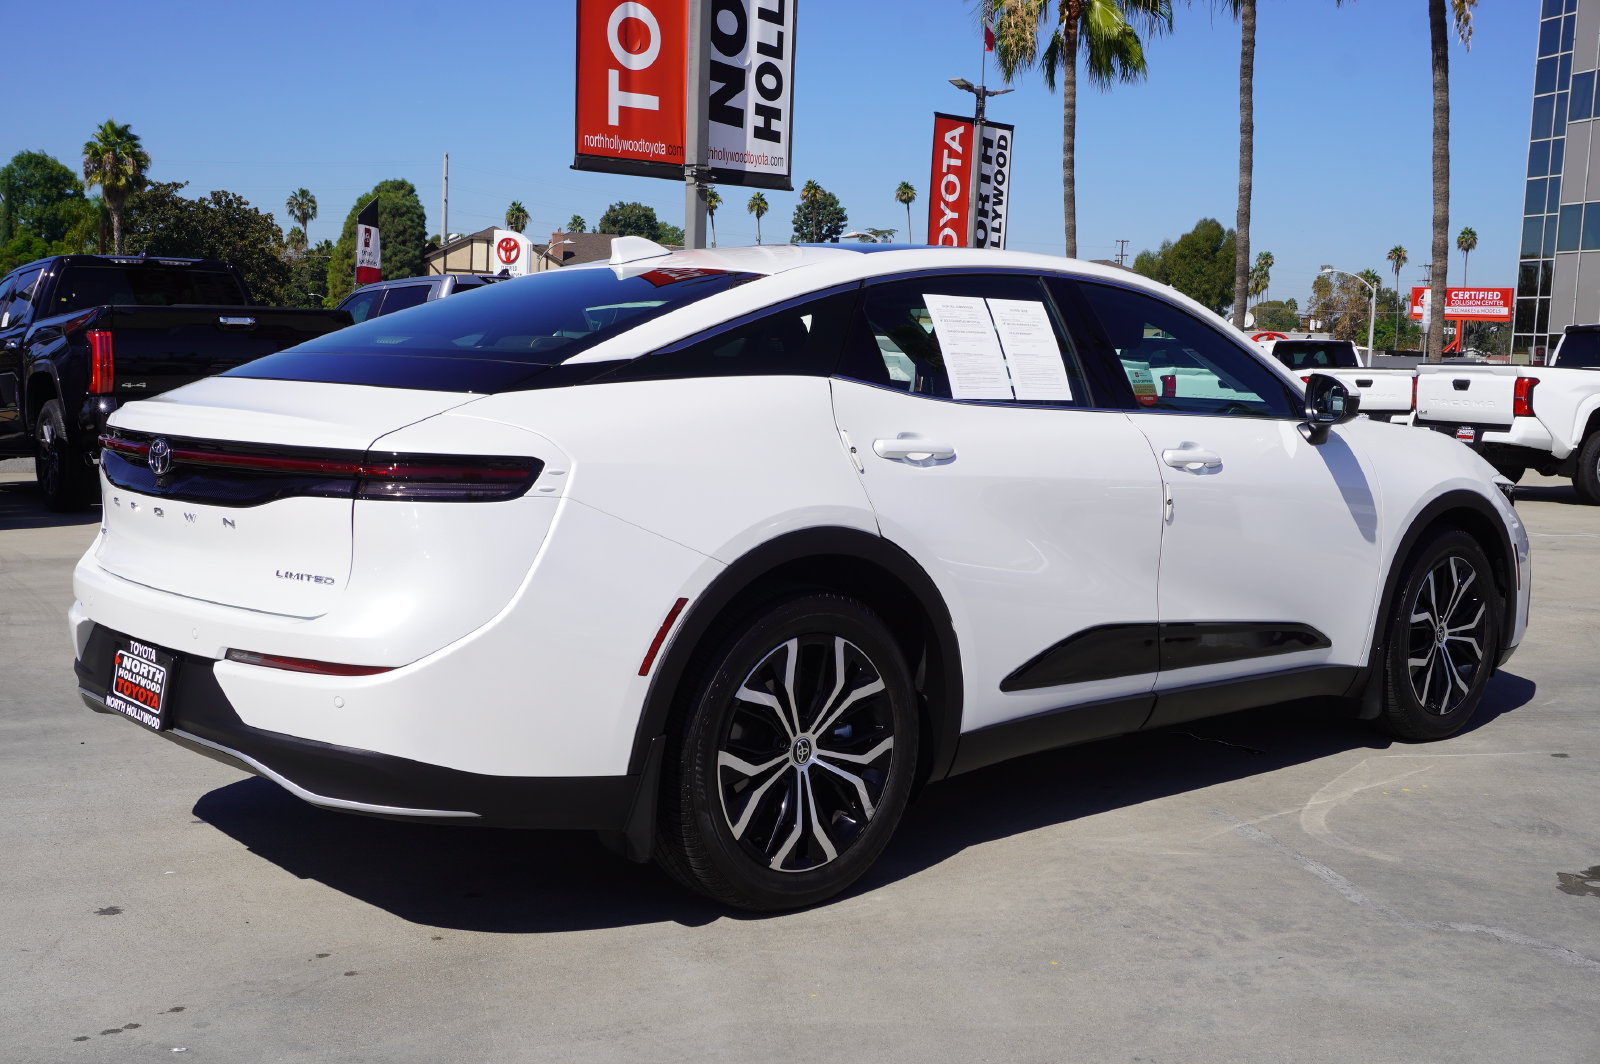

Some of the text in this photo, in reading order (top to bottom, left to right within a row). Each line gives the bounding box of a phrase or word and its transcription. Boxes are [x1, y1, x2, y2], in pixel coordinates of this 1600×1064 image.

[584, 133, 684, 157] northhollywoodtoyota.com
[1451, 291, 1501, 300] CERTIFIED
[275, 569, 335, 585] LIMITED
[130, 641, 156, 662] TOYOTA
[118, 667, 161, 694] HOLLYWOOD
[123, 656, 164, 684] NORTH
[117, 677, 160, 710] TOYOTA
[105, 695, 160, 730] NORTH HOLLYWOOD
